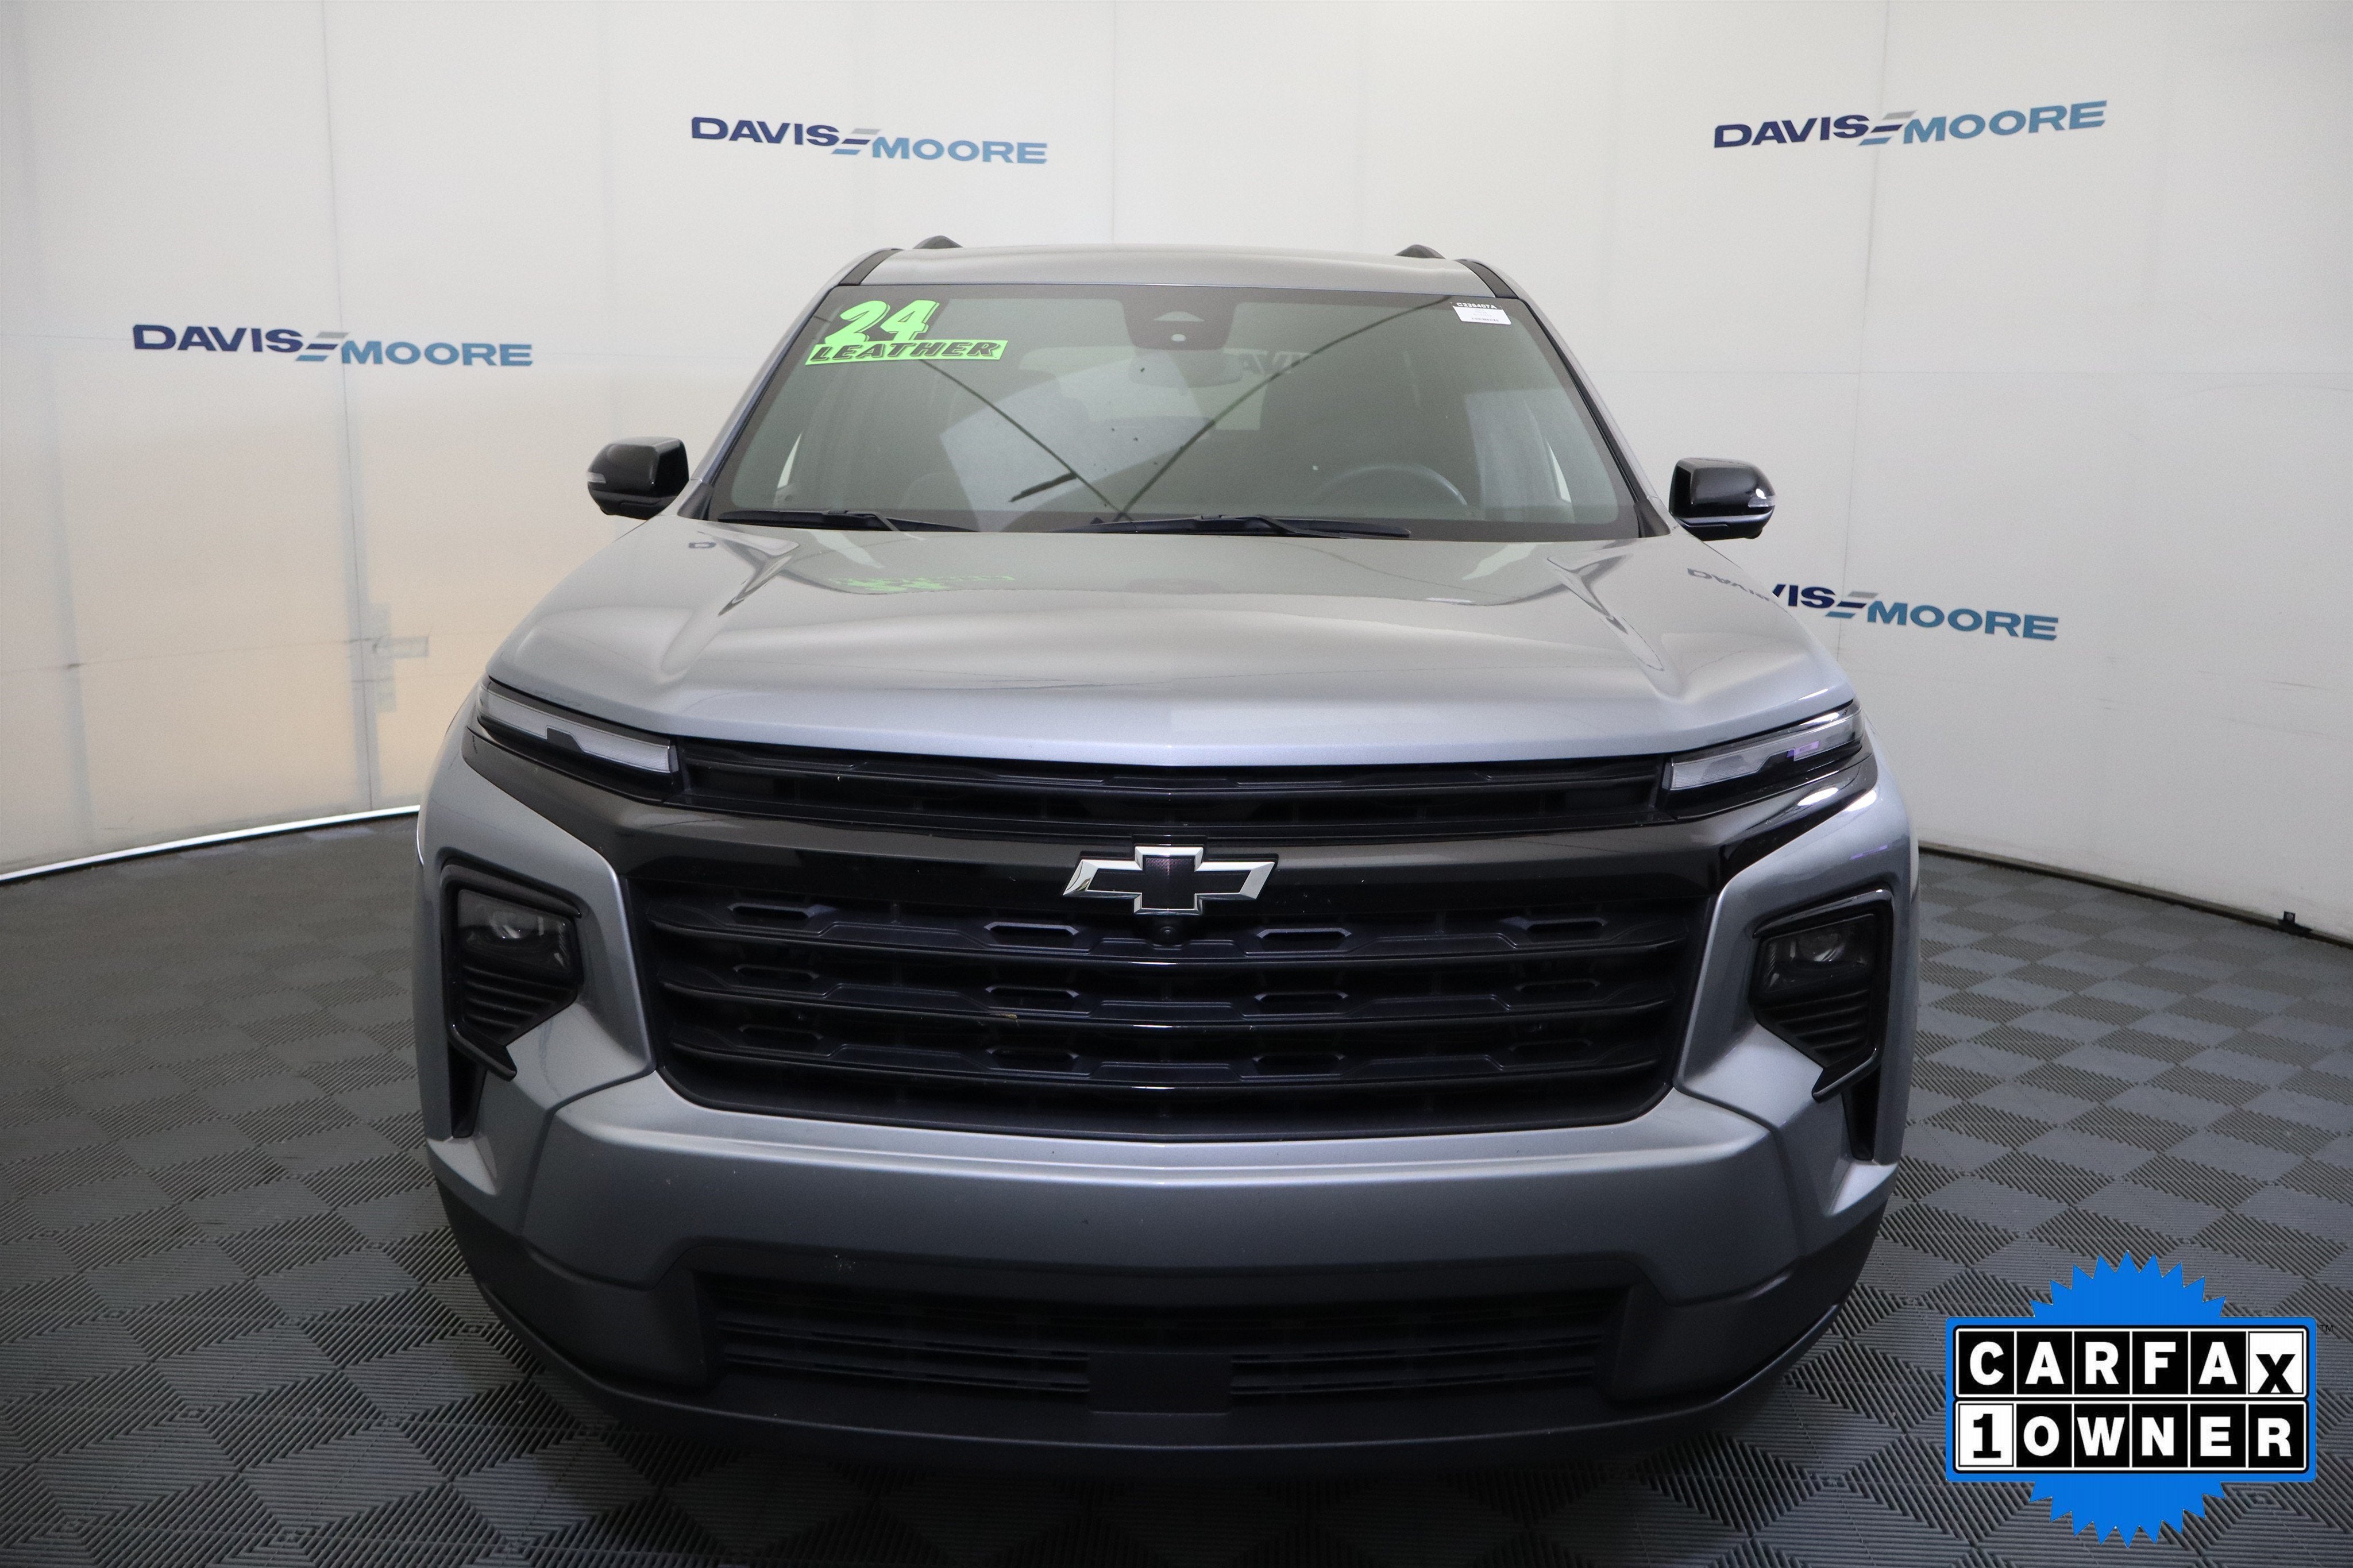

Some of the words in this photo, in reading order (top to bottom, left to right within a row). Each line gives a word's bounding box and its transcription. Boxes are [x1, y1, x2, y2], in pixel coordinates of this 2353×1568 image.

[691, 116, 840, 147] DAVIS
[872, 136, 1048, 164] MOORE
[1714, 115, 1869, 148] DAVIS
[1903, 100, 2107, 144] MOORE
[824, 300, 940, 344] 24
[133, 323, 304, 353] DAVIS
[341, 339, 533, 366] MOORE
[810, 342, 1000, 362] LEATHER
[1866, 600, 2058, 640] MOORE
